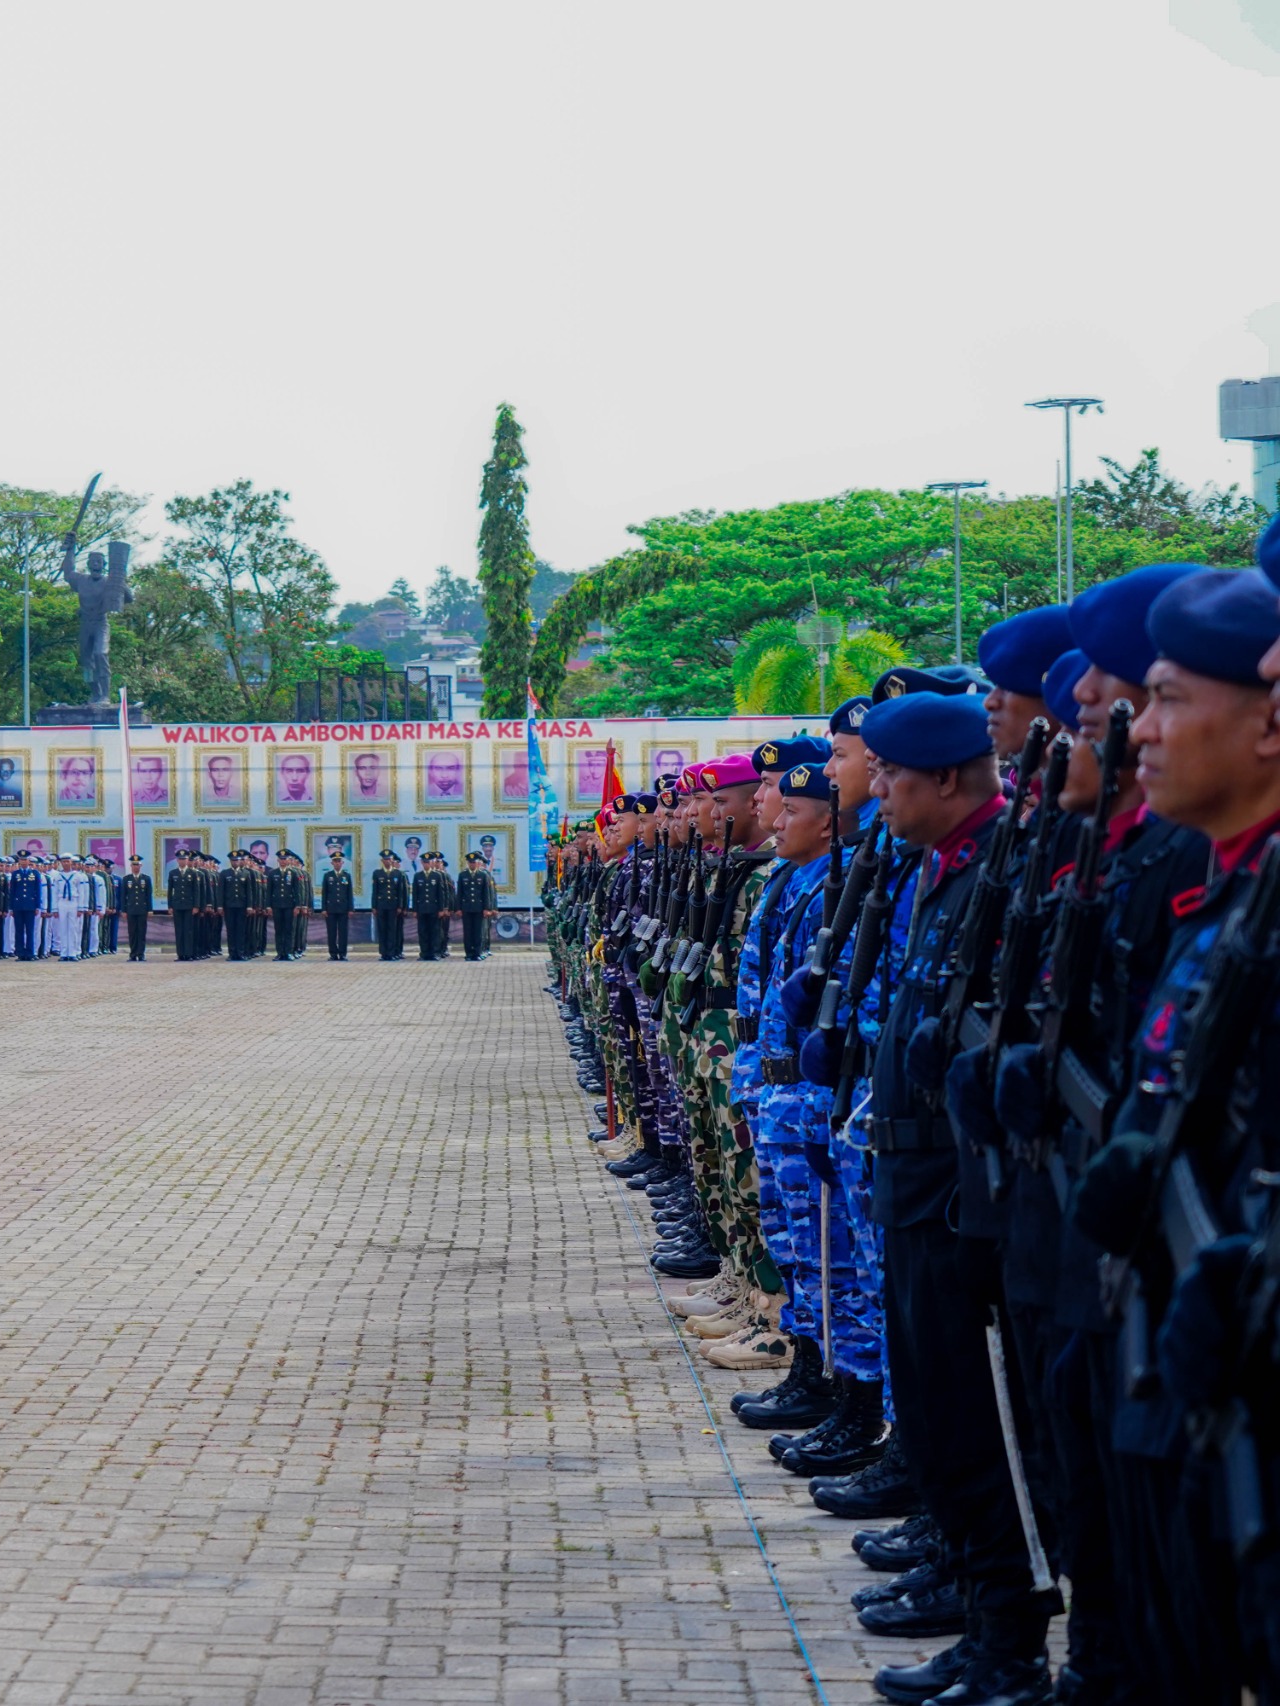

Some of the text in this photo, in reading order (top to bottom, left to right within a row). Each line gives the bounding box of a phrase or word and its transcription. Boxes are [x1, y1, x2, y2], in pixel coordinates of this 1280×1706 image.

[161, 720, 594, 744] WALIKOTA AMBON DARI MASA KE MASA
